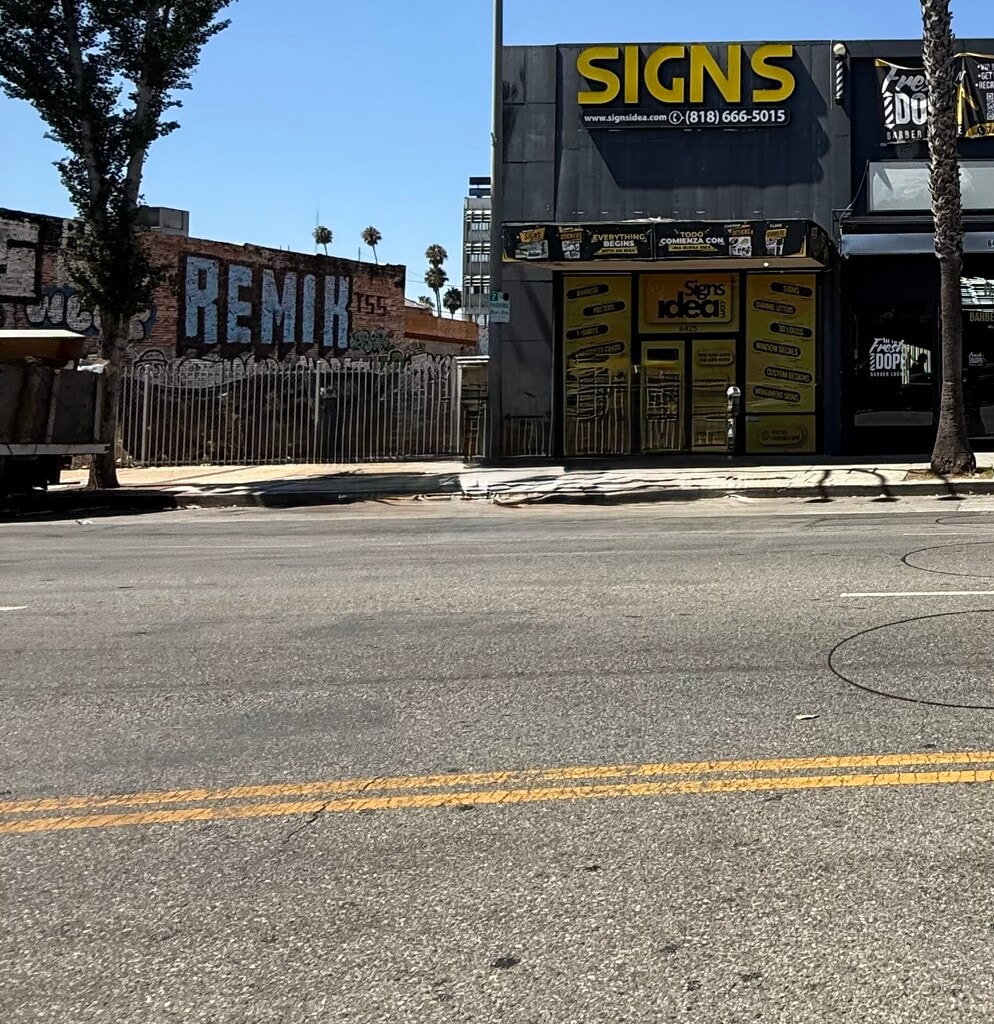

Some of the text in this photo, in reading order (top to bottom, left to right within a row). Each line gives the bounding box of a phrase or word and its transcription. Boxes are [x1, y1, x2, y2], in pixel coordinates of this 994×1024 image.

[577, 44, 795, 104] SIGNS
[981, 71, 993, 80] GET
[584, 109, 786, 125] www.signsidea.com (818) 666-5015
[886, 129, 923, 141] BARBER
[592, 233, 646, 241] EVERYTHING
[660, 236, 724, 245] COMIENZA CON
[684, 279, 726, 301] Signs
[658, 291, 720, 319] idea
